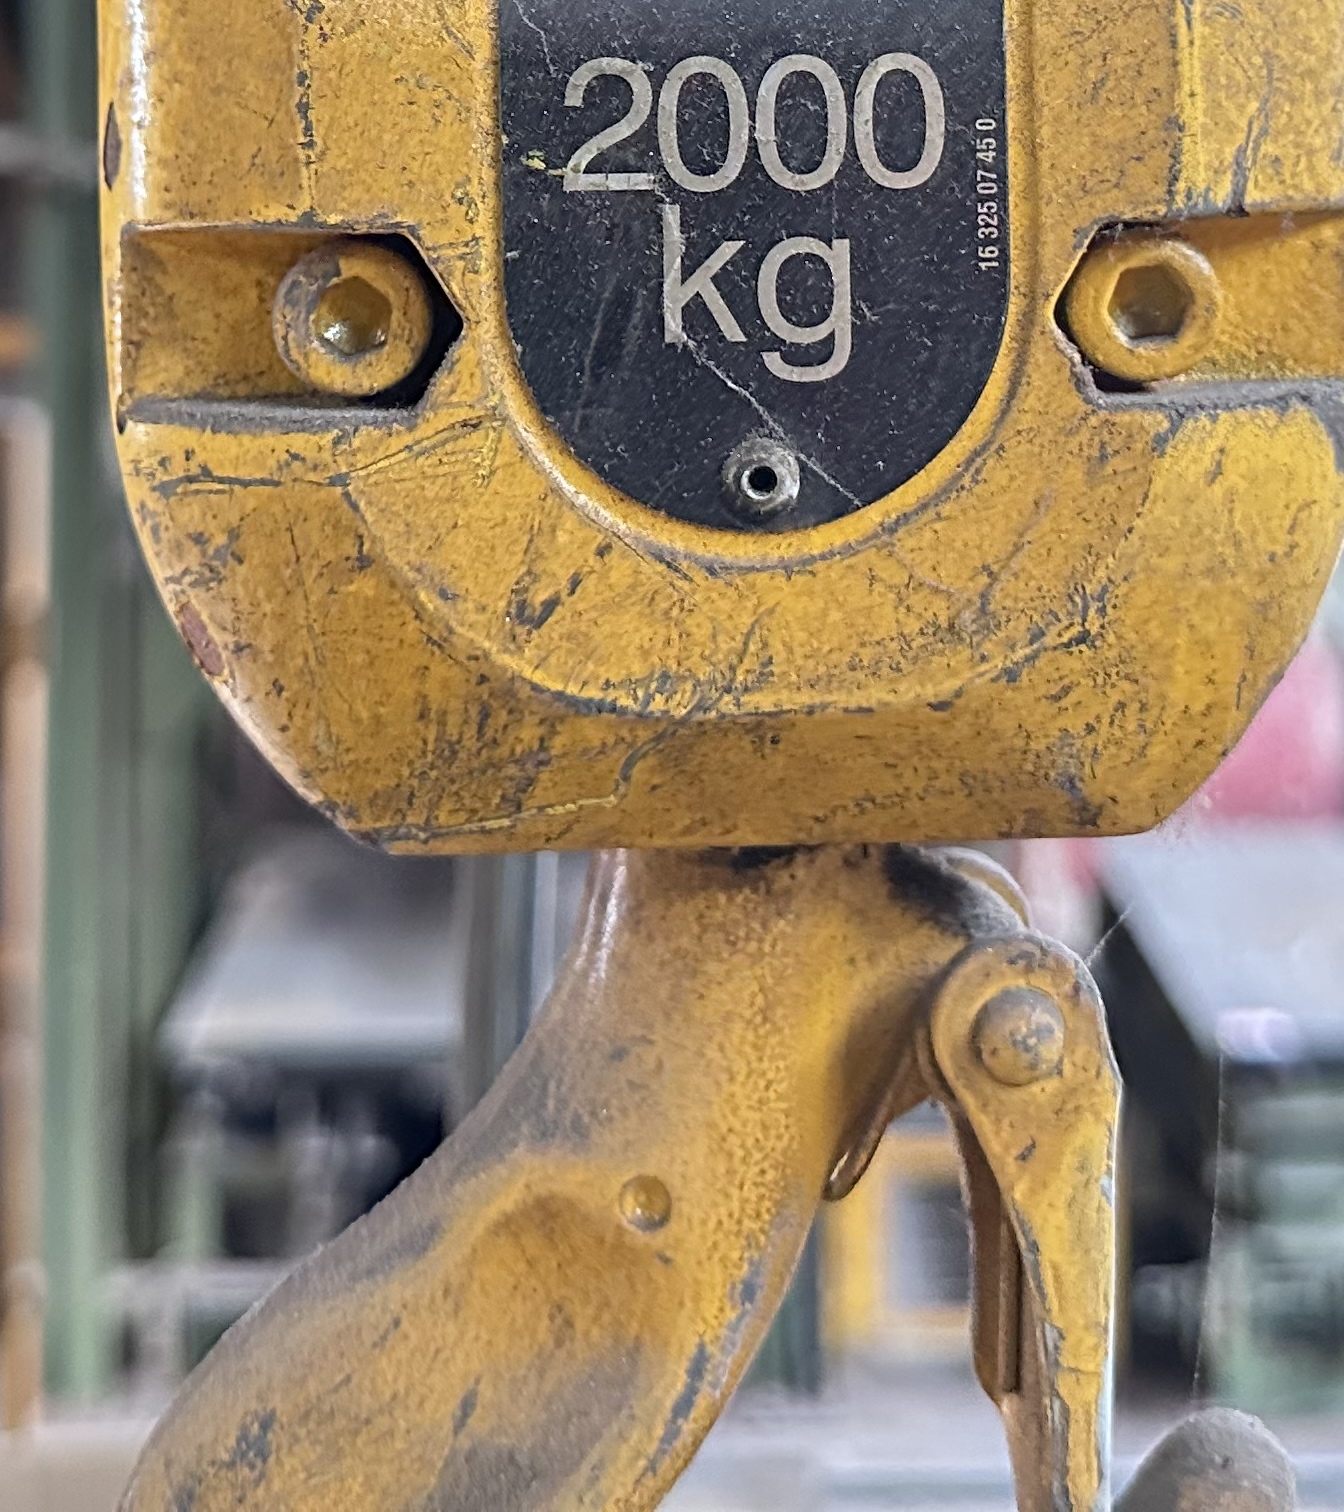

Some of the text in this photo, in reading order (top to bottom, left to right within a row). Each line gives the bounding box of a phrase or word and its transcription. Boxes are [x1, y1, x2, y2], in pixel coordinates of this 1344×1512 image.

[562, 52, 945, 192] 2000
[975, 118, 1000, 271] 16 325 07 45 0
[661, 203, 853, 383] kg
